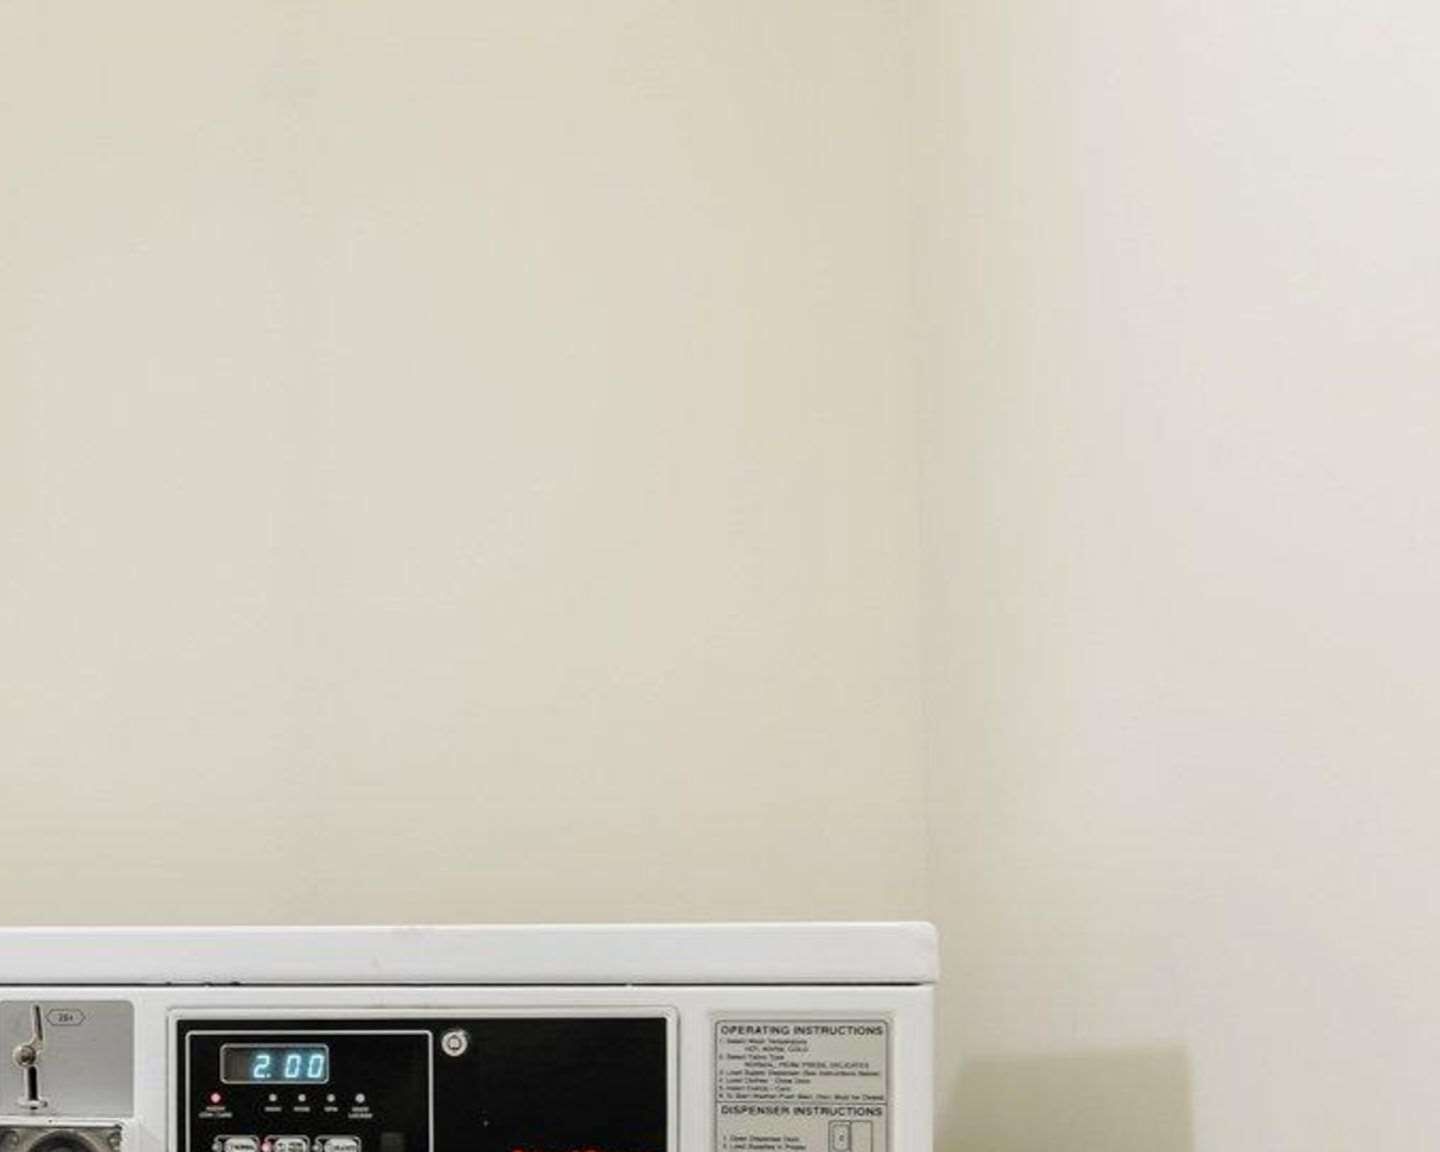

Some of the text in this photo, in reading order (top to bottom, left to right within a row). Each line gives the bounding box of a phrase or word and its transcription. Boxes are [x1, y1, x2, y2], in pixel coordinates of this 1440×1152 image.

[720, 1025, 883, 1036] OPERATING INSTRUCTIONS
[720, 1106, 883, 1117] DISPENSER INSTRUCTIONS
